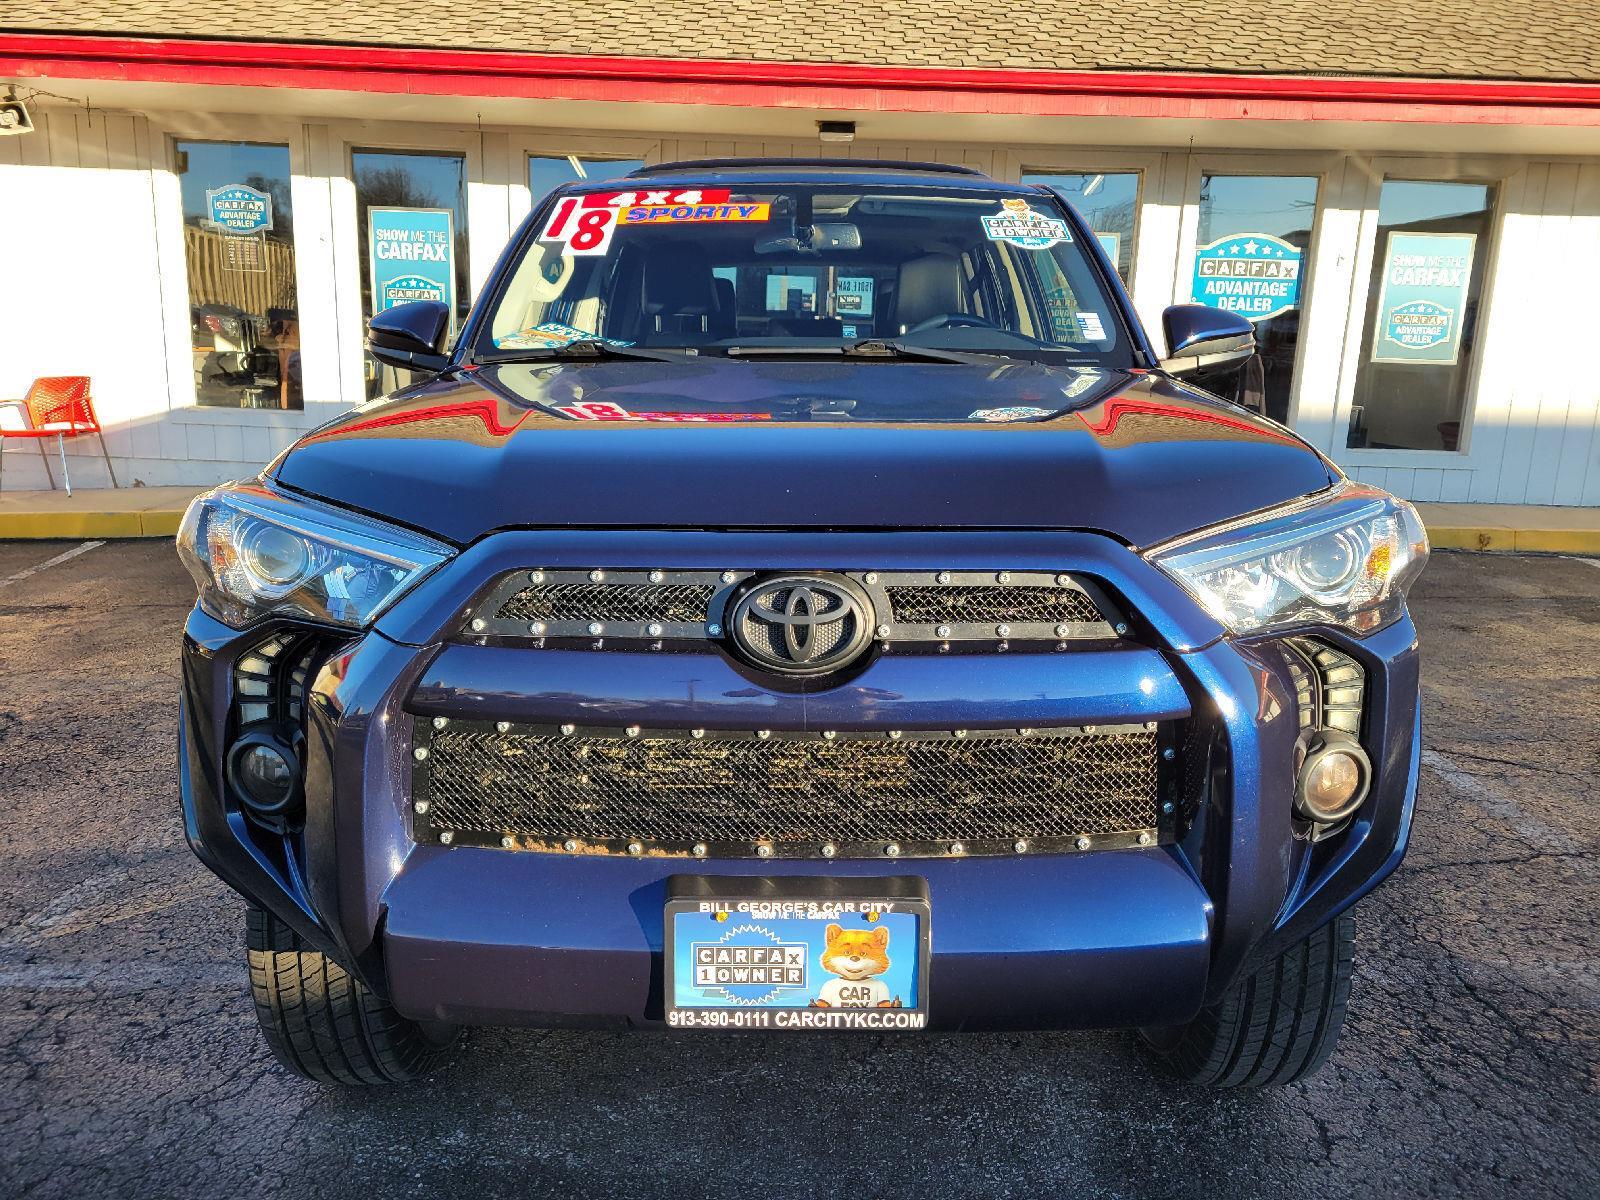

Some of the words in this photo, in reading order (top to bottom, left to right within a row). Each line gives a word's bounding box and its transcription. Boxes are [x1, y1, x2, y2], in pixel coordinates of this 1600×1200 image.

[216, 201, 264, 211] CARFAX
[625, 205, 760, 222] SPORTY
[220, 211, 261, 220] ADVANTAGE
[376, 228, 408, 241] SHOW
[411, 230, 425, 242] ME
[427, 231, 446, 243] THE
[377, 241, 447, 261] CARFAX
[1203, 261, 1293, 278] CARFAX
[1393, 255, 1426, 267] SHOW
[1427, 256, 1446, 268] ME
[1447, 256, 1466, 269] THE
[1392, 267, 1466, 288] CARFAX
[388, 289, 438, 299] CARFAX
[1204, 280, 1288, 297] ADVANTAGE
[1217, 297, 1273, 312] DEALER
[1394, 315, 1445, 325] CARFAX
[1396, 326, 1443, 335] ADVANTAGE
[1402, 334, 1432, 343] DEALER
[700, 902, 733, 913] BILL
[737, 902, 819, 913] GEORGE'S
[822, 902, 855, 913] CAR
[859, 902, 894, 913] CITY
[699, 949, 800, 965] CARFAX
[838, 986, 871, 1000] CAR
[669, 1011, 769, 1026] 913-390-0111
[774, 1011, 924, 1027] CARCITYKC.COM
